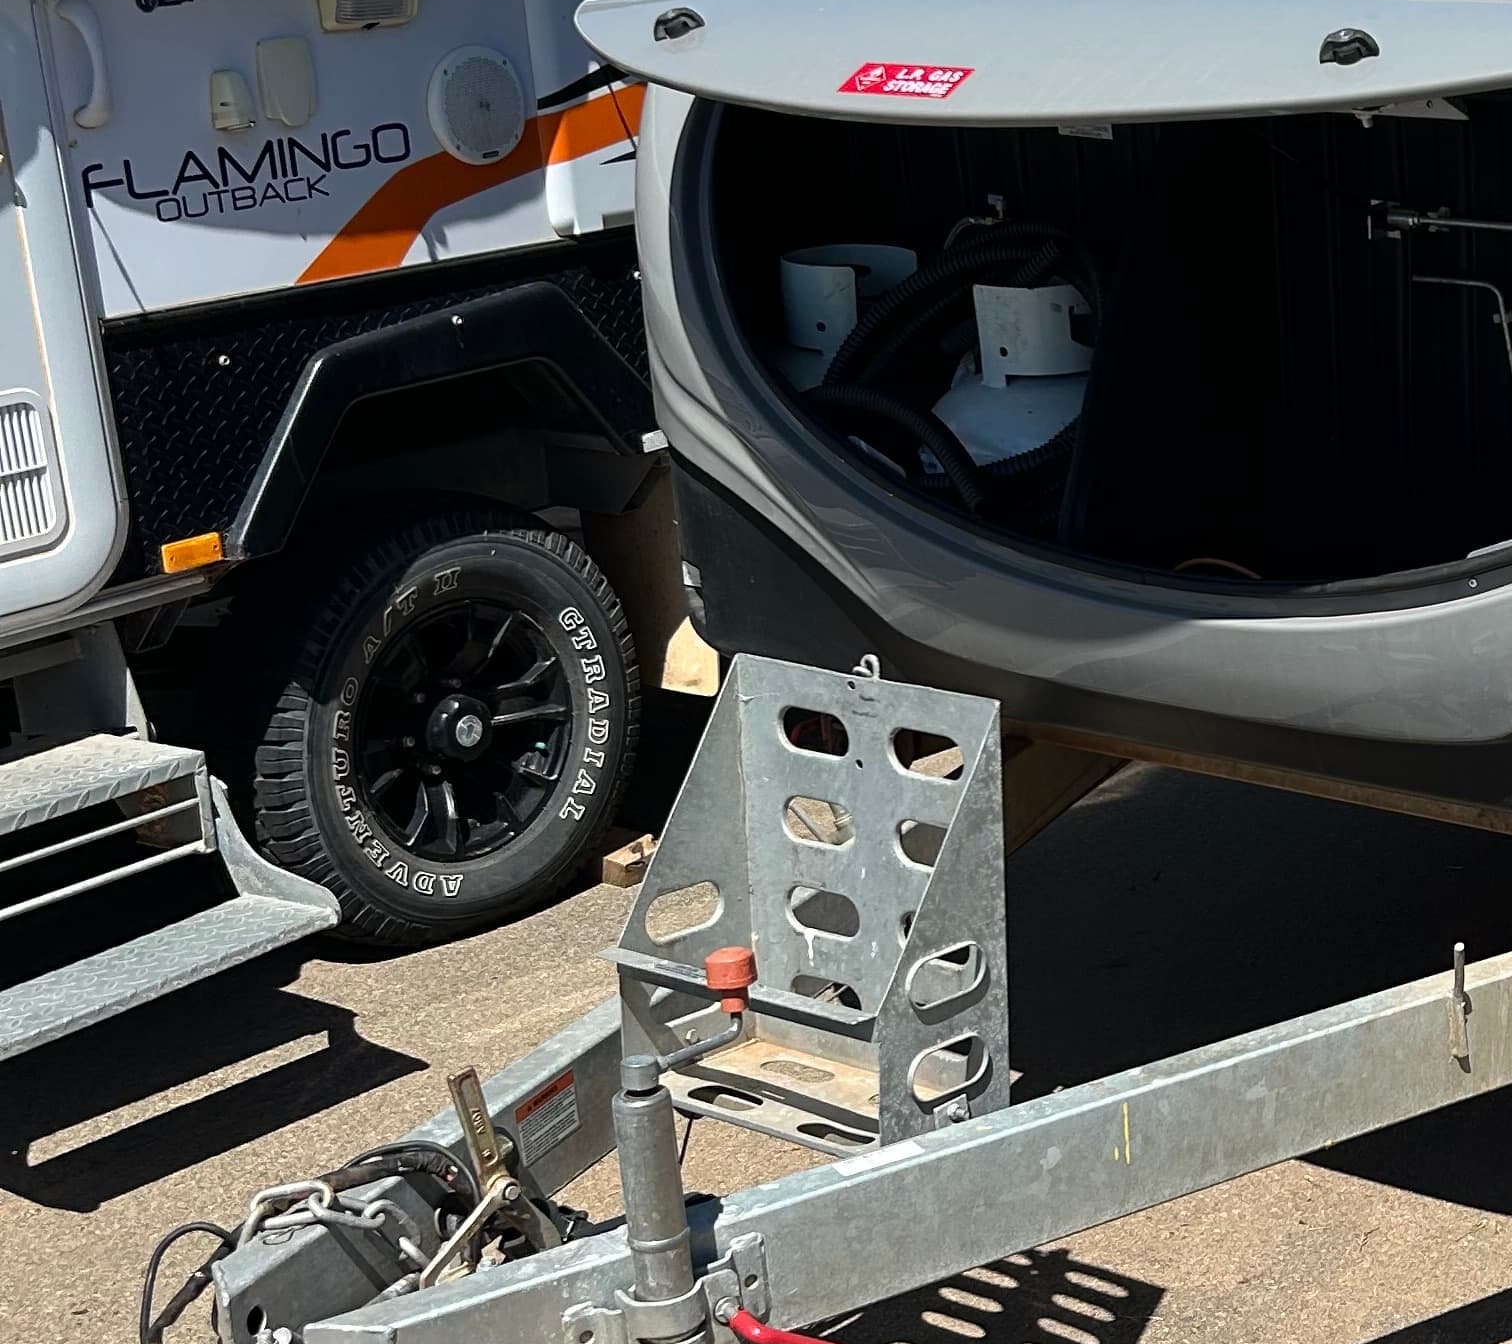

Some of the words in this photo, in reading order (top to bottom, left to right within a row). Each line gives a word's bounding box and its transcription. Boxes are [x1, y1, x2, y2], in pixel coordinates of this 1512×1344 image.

[928, 70, 964, 82] GAS
[81, 122, 411, 209] FLAMINGO
[155, 173, 330, 223] OUTBACK
[331, 676, 464, 897] ADVENTURO
